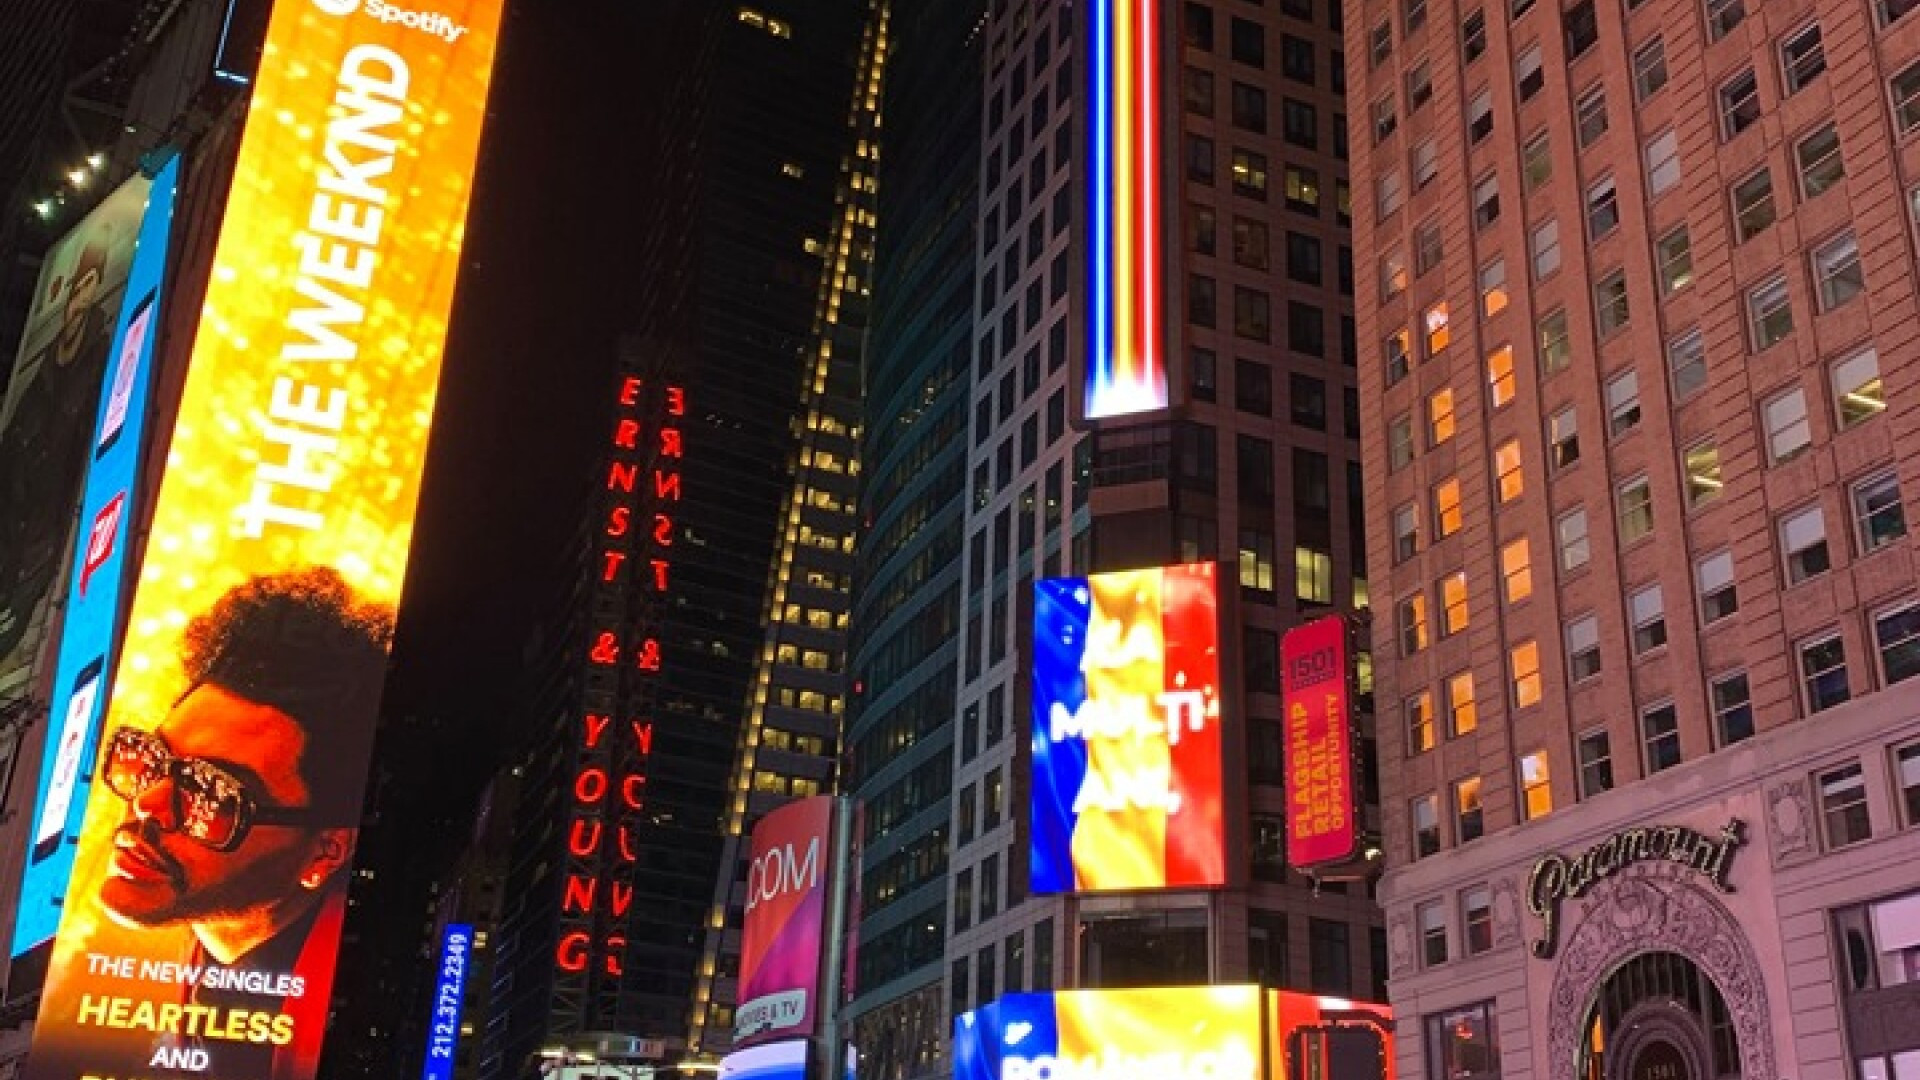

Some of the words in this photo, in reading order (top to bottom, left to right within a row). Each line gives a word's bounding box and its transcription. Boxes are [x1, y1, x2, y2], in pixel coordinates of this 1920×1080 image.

[365, 0, 467, 43] Spotify
[279, 43, 410, 363] WEEKND
[239, 374, 348, 538] THE
[604, 377, 642, 582] ERNST
[590, 631, 619, 664] &
[1290, 702, 1313, 839] FLAGSHIP
[1311, 737, 1330, 834] RETAIL
[1325, 693, 1345, 830] OPPORTUNITY
[556, 714, 610, 972] YOUNG
[1528, 817, 1748, 960] Paramount
[77, 993, 294, 1045] HEARTLESS
[87, 952, 136, 979] THE
[139, 959, 201, 985] NEW
[202, 965, 306, 997] SINGLES
[149, 1045, 210, 1072] AND
